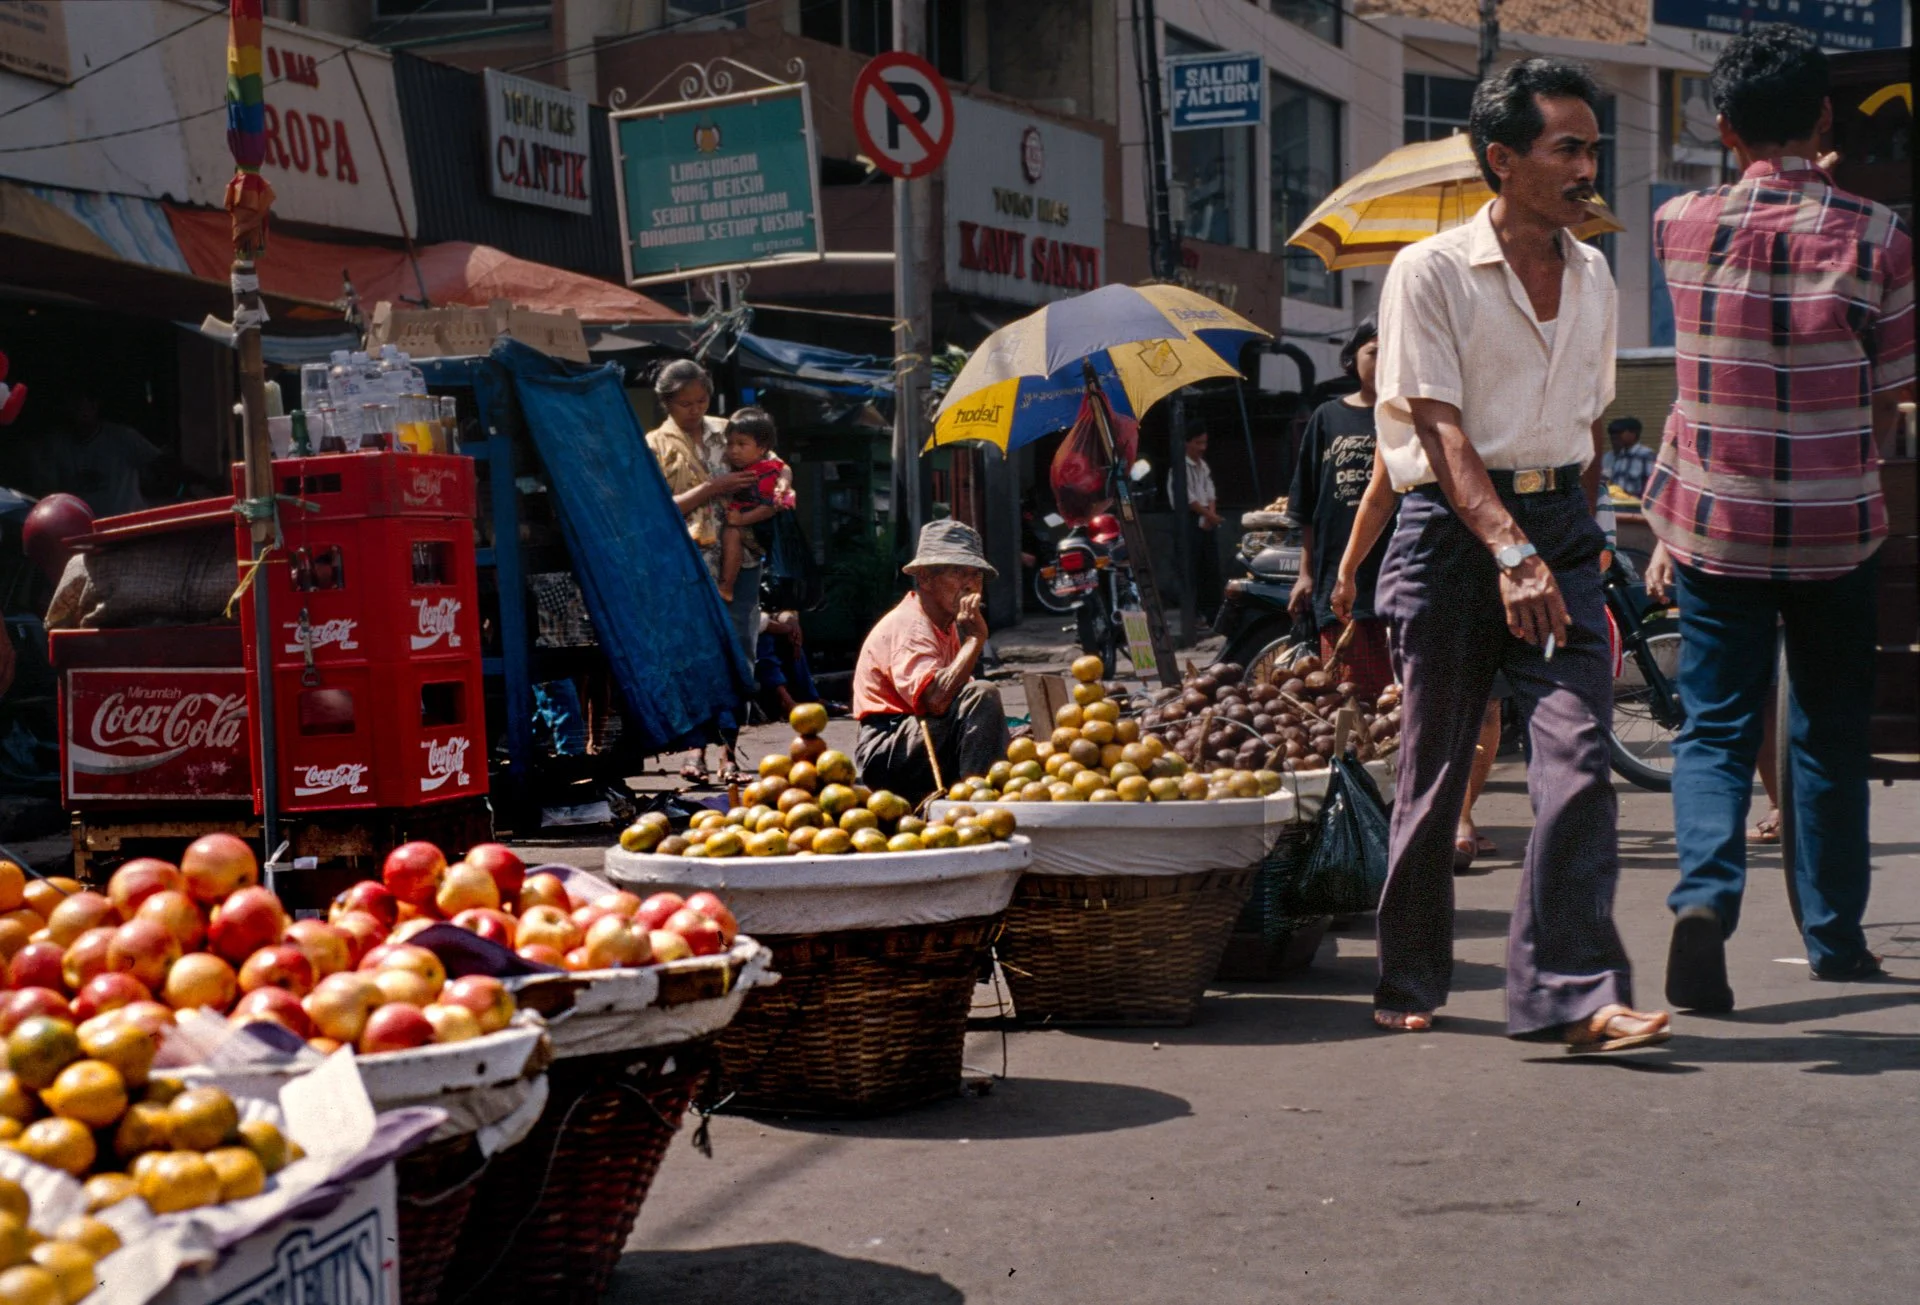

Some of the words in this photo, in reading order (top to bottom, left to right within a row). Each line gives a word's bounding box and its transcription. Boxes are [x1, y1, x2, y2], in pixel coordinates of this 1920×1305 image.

[1186, 64, 1249, 87] SALON
[1175, 82, 1259, 108] FACTORY
[886, 82, 930, 149] P
[497, 135, 587, 200] CANTIK
[671, 153, 758, 182] LINGKUNGAN
[671, 182, 708, 204] YANG
[713, 175, 764, 198] BERSIH
[652, 205, 697, 227] SEHAT
[701, 202, 728, 221] DAN
[731, 192, 788, 216] NYAMAN
[708, 218, 758, 240] SETIAP
[762, 211, 804, 233] INSAN
[959, 220, 1026, 279] KAWI
[1031, 236, 1100, 291] SAKTI
[128, 687, 182, 699] Minumlah
[91, 692, 248, 749] Coca-Cola
